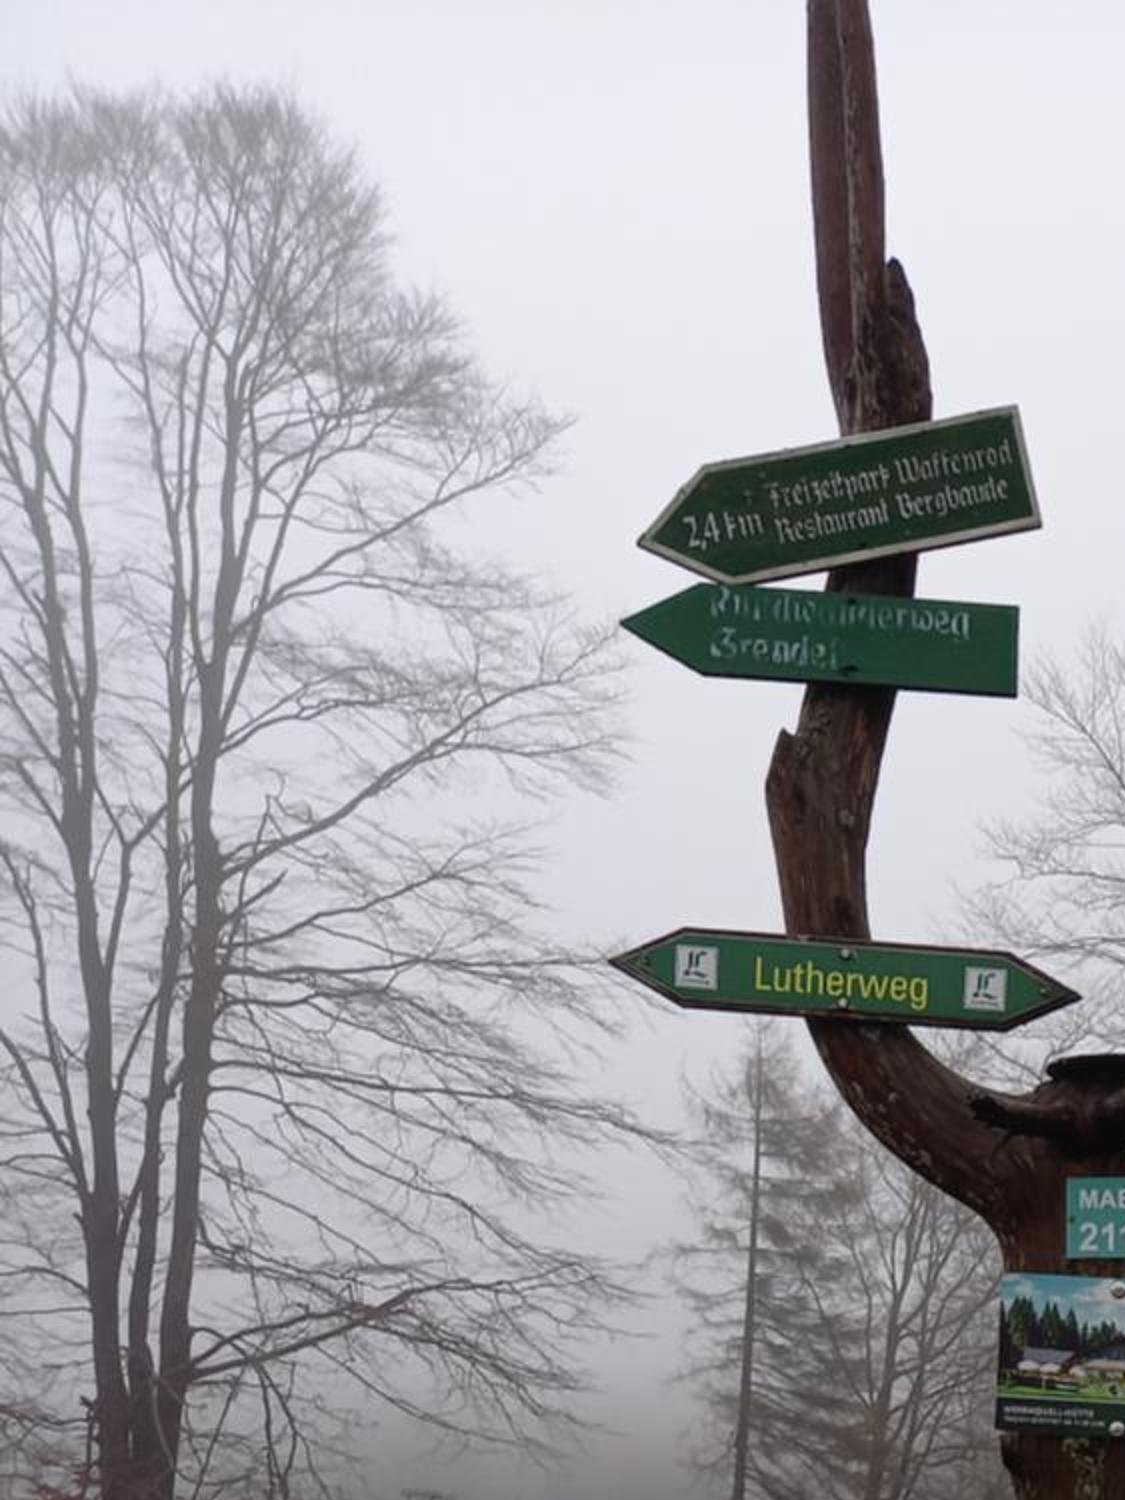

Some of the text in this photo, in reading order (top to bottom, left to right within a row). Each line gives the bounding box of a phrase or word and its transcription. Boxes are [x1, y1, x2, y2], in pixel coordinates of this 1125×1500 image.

[895, 438, 1013, 487] Waffenrod
[774, 503, 890, 546] Restaurant
[754, 957, 928, 1010] Lutherweg
